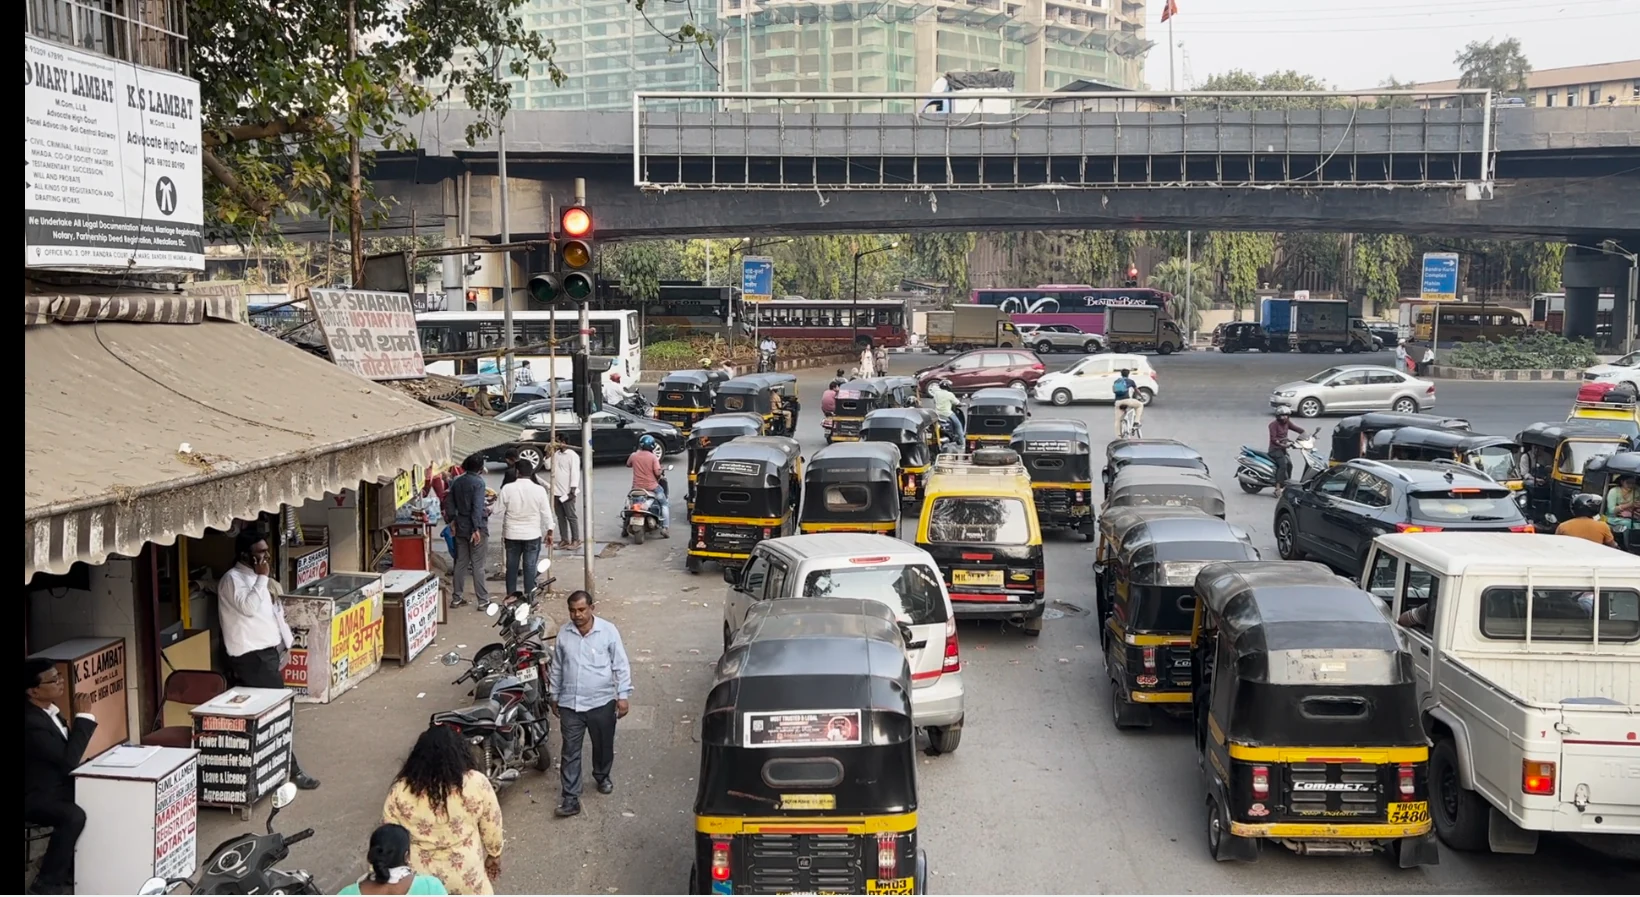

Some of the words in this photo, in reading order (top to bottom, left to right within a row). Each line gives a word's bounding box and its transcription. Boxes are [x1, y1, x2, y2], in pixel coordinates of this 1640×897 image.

[34, 62, 67, 93] MARY
[70, 70, 114, 103] LAMBAT
[148, 90, 193, 120] LAMBAT
[47, 109, 71, 120] Advocate
[72, 115, 83, 123] High
[84, 116, 97, 124] Court
[26, 116, 41, 126] Panel
[80, 127, 97, 136] Central
[98, 130, 116, 141] Railway
[126, 130, 162, 149] Advocate
[163, 137, 179, 154] High
[180, 140, 198, 156] Court
[74, 155, 93, 164] SOCIETY
[94, 159, 114, 167] MATTERS
[59, 175, 80, 183] PROBATE
[35, 194, 61, 202] DRAFTING
[44, 184, 60, 192] KINDS
[69, 186, 102, 196] REGISTRATION
[28, 216, 39, 225] We
[40, 217, 72, 226] Undertake
[82, 220, 98, 230] Legal
[99, 220, 139, 231] Documentation
[156, 226, 175, 235] Marriage
[52, 231, 76, 241] Notary,
[76, 232, 107, 243] Partnership
[108, 234, 123, 242] Deed
[346, 293, 411, 312] SHARMA
[349, 312, 392, 328] NOTARY
[309, 548, 328, 563] SHARMA
[298, 566, 318, 585] NOTARY
[417, 581, 437, 600] SHARMA
[407, 592, 437, 620] NOTARY
[338, 606, 365, 640] AMAR
[352, 619, 382, 652] अमर
[91, 646, 122, 676] LAMBAT
[98, 685, 109, 700] HIGH
[110, 678, 123, 695] COURT
[200, 736, 217, 747] Power
[218, 736, 224, 748] Of
[225, 736, 250, 751] Attorney
[197, 753, 228, 767] Agreement
[229, 754, 238, 766] For
[239, 754, 252, 767] Sale
[158, 776, 173, 795] SUNIL
[202, 770, 218, 783] Leave
[220, 773, 224, 783] &
[225, 771, 247, 785] License
[158, 794, 175, 811] ADVOCATE
[176, 789, 184, 798] HIGH
[185, 780, 195, 793] COURT
[203, 788, 246, 802] Agreements
[157, 790, 196, 826] MARRIAGE
[1390, 811, 1427, 823] 5480
[157, 806, 195, 842] REGISTRATION
[157, 826, 187, 860] NOTARY
